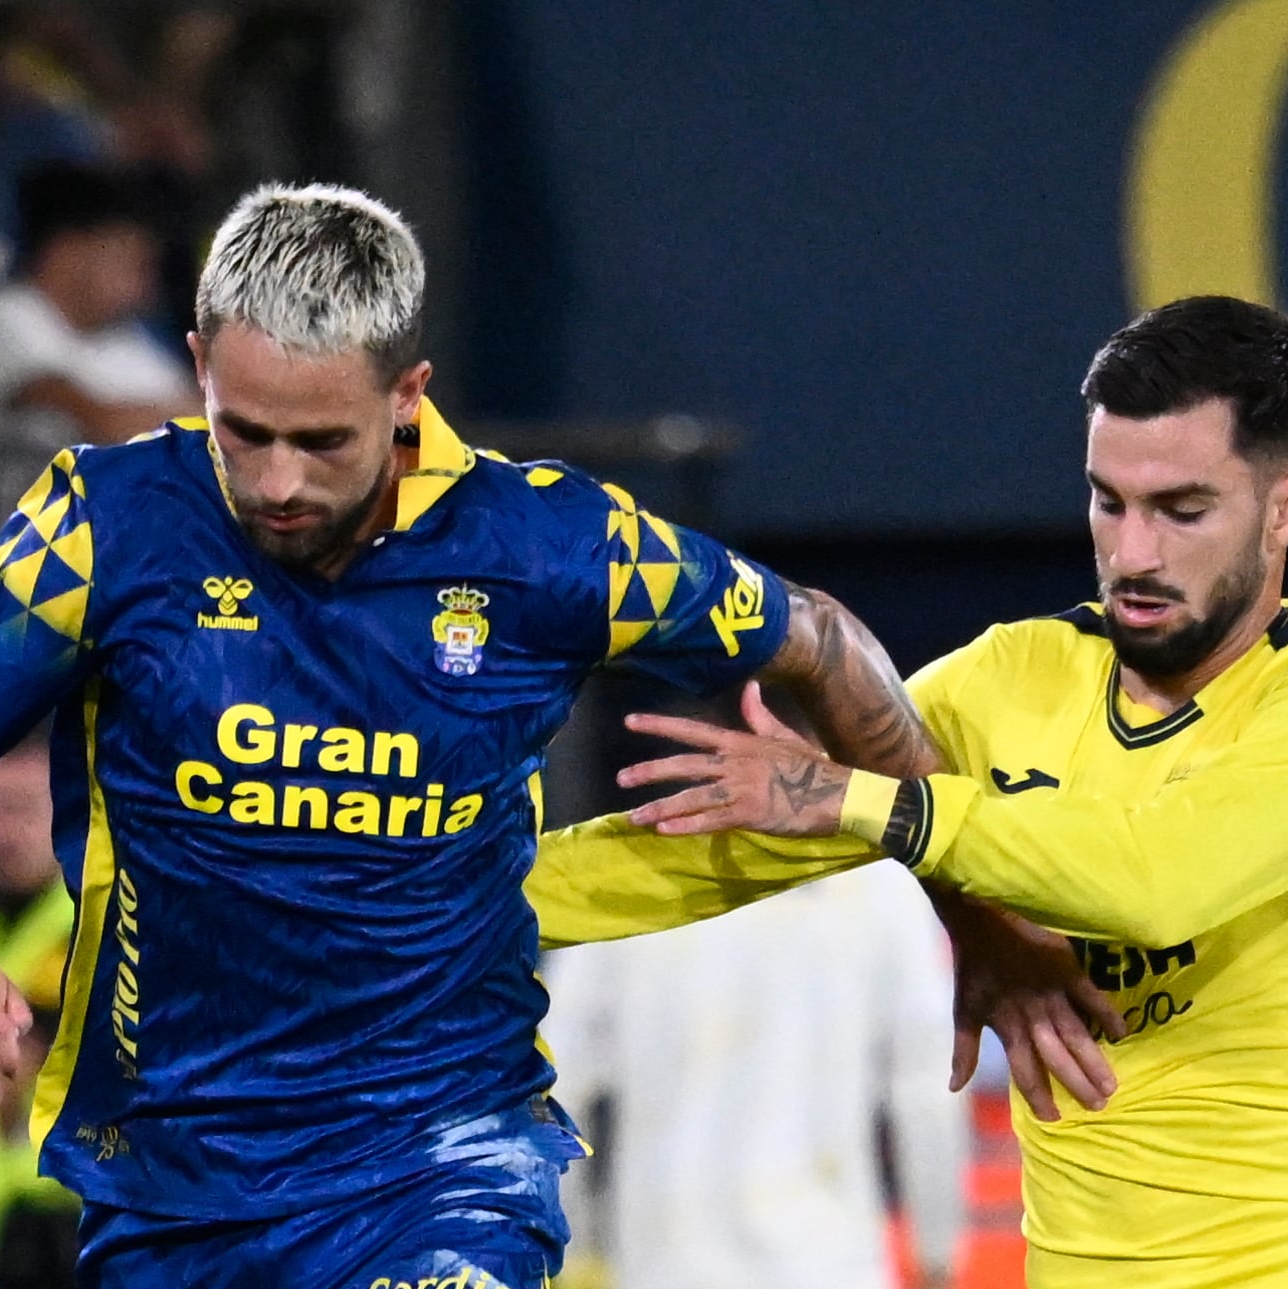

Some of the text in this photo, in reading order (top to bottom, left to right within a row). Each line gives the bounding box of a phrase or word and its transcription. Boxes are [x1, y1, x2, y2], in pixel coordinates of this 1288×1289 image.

[197, 611, 259, 632] hummel
[216, 703, 419, 778] Gran
[174, 760, 484, 838] Canaria
